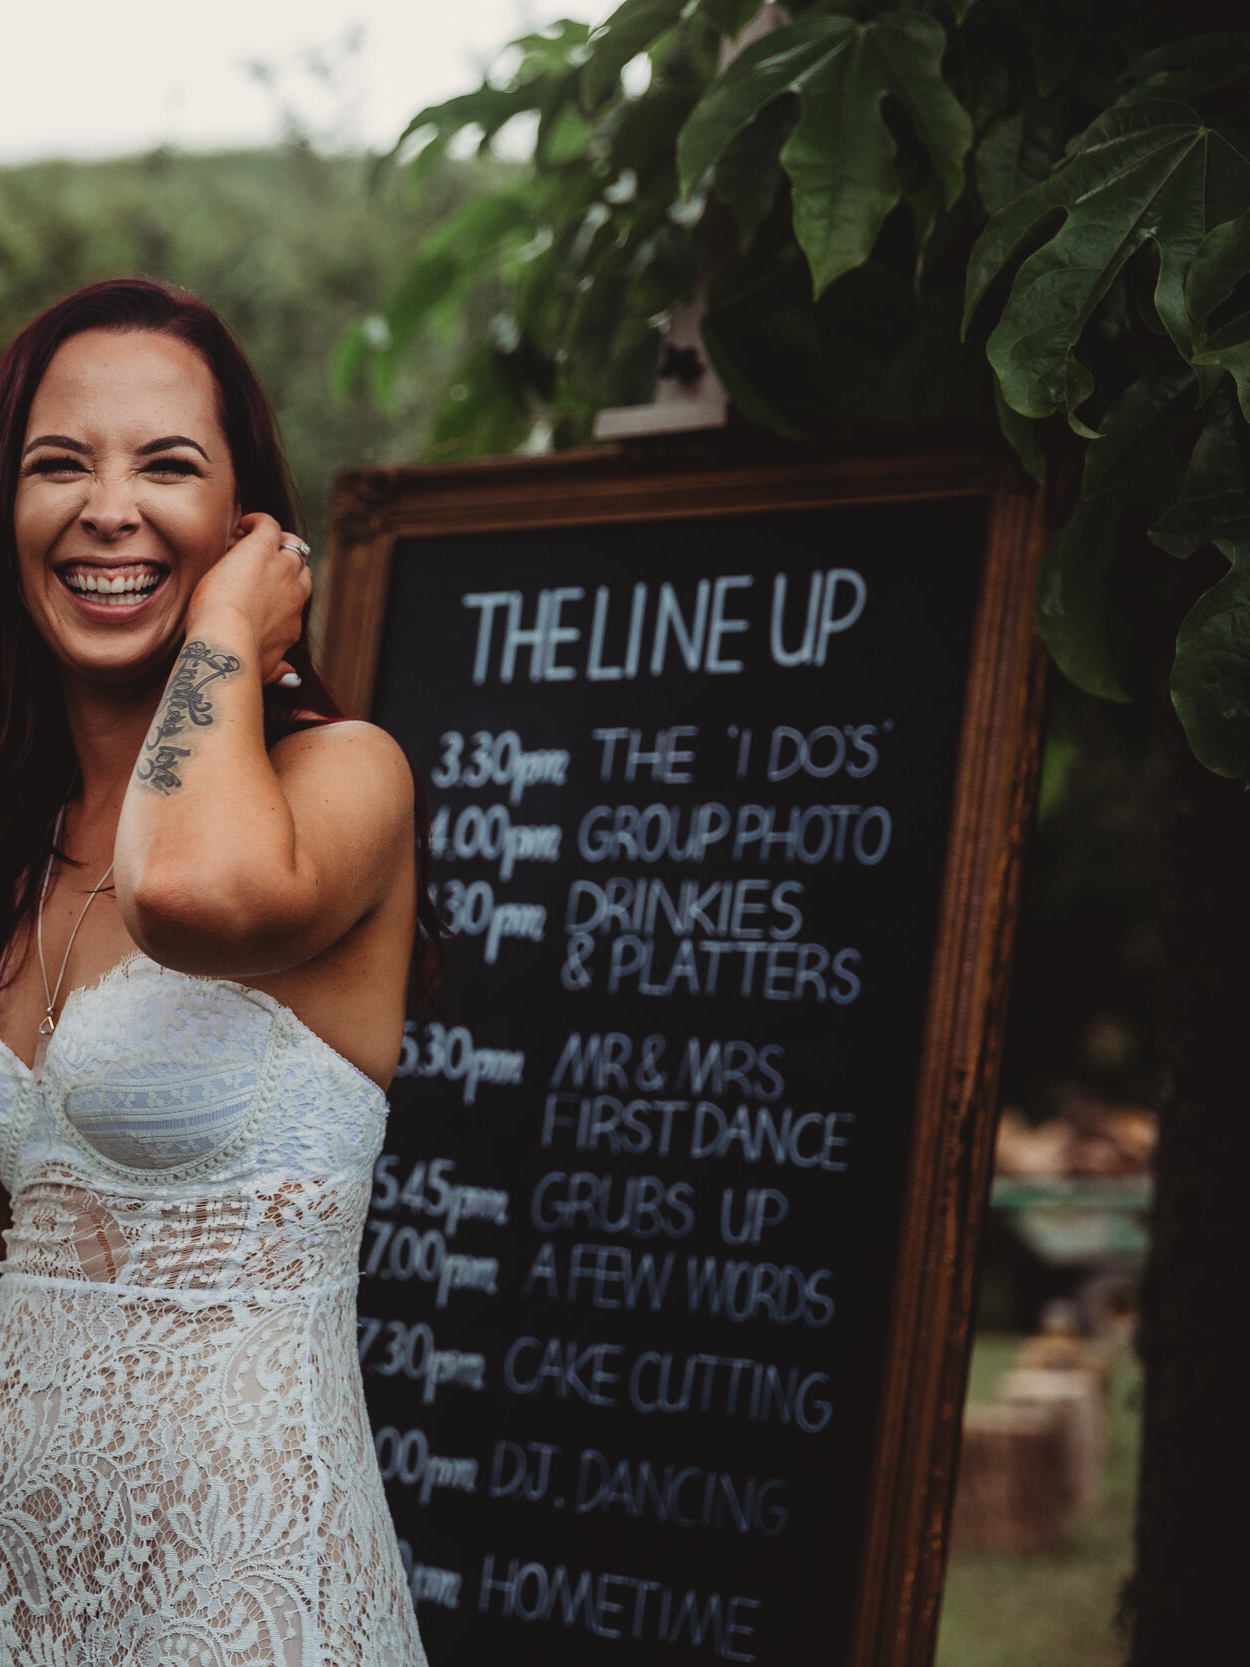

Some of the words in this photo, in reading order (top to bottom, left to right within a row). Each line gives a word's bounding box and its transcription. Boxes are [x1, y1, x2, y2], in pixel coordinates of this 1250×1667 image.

[462, 587, 585, 685] THE
[587, 575, 753, 681] LINE
[770, 568, 867, 667] UP
[592, 725, 699, 784] THE
[577, 802, 730, 864] GROUP
[732, 804, 892, 865] PHOTO
[565, 878, 805, 940] DRINKIES
[560, 933, 594, 991] &
[608, 939, 862, 1005] PLATTERS
[550, 1032, 632, 1090] MR
[635, 1033, 667, 1091] &
[679, 1036, 786, 1101] MRS
[541, 1091, 690, 1158] FIRST
[689, 1101, 856, 1172] DANCE
[530, 1171, 695, 1240] GRUBS
[720, 1188, 789, 1246] UP
[522, 1243, 558, 1304] A
[567, 1243, 676, 1313] FEW
[685, 1255, 836, 1328] WORDS
[503, 1335, 626, 1407] CAKE
[629, 1351, 834, 1434] CUTTING
[576, 1447, 790, 1538] DANCING
[478, 1553, 763, 1664] HOMETIME
